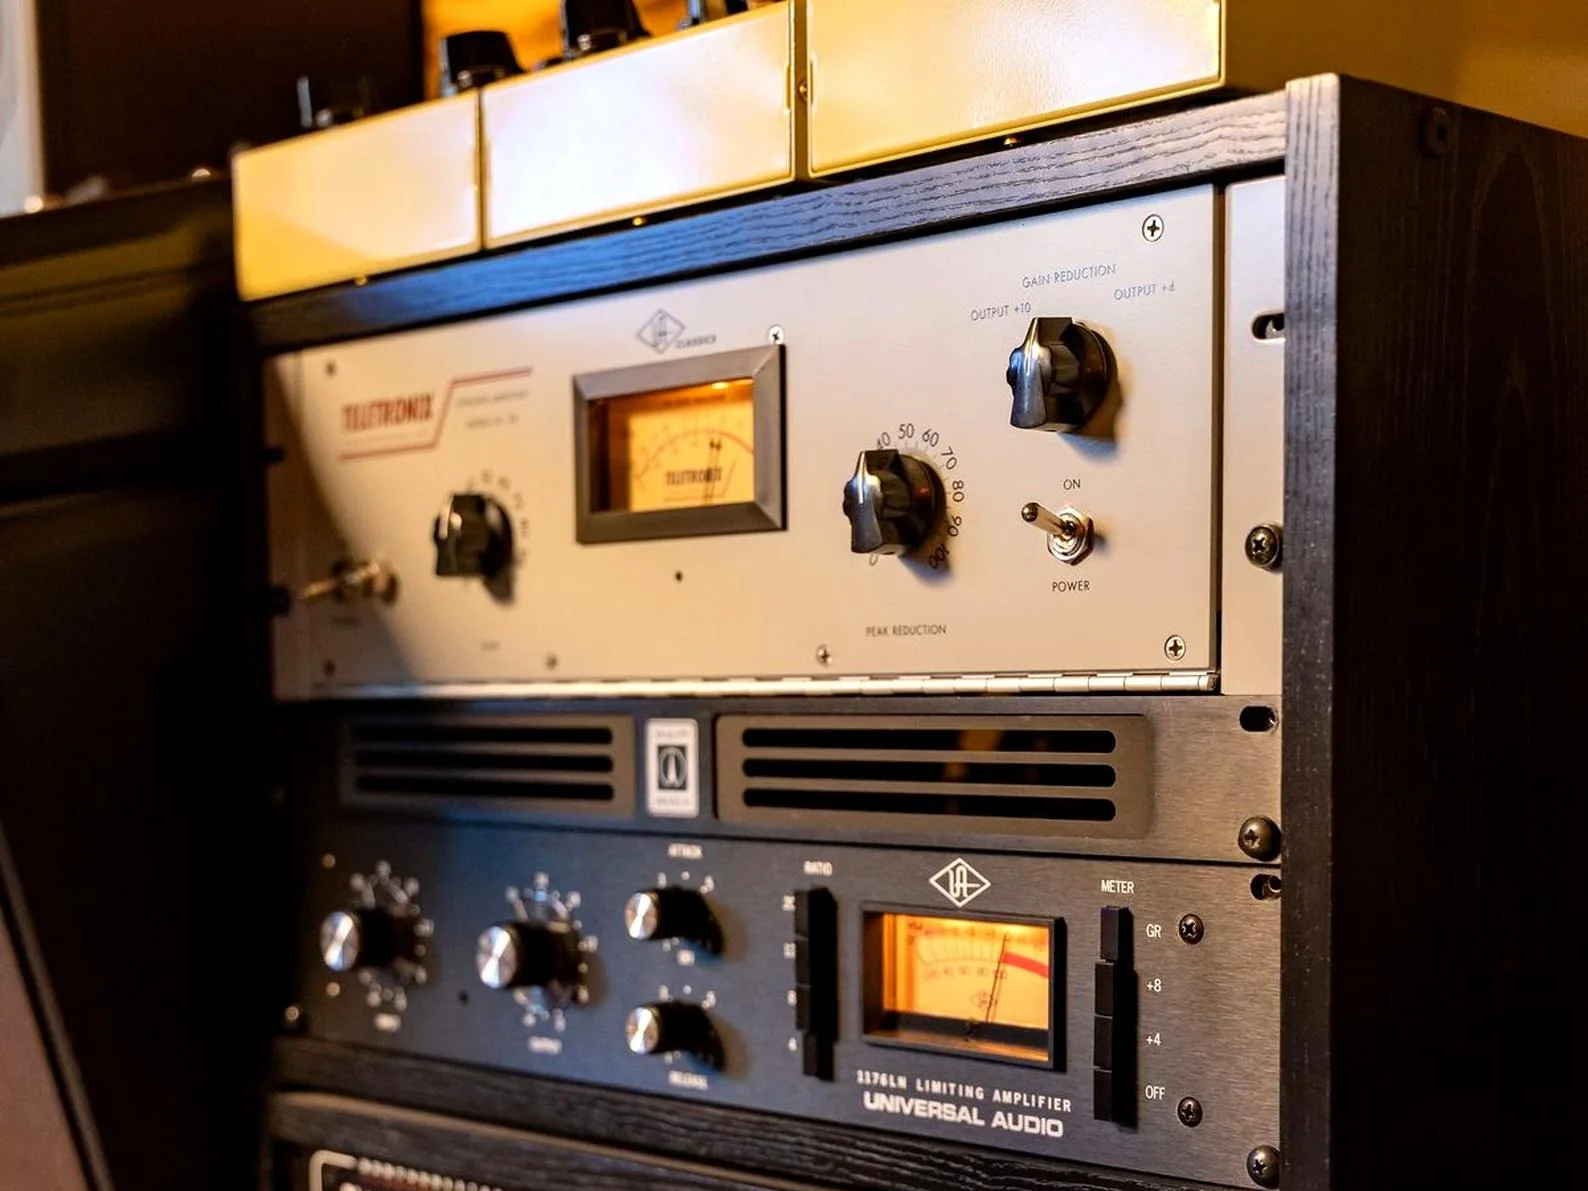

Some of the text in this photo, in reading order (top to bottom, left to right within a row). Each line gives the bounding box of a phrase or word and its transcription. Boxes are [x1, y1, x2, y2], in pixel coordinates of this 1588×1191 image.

[1022, 264, 1117, 288] GAIN REDUCTION
[1113, 284, 1156, 300] OUTPUT
[970, 302, 1032, 321] OUTPUT +10
[898, 423, 915, 440] 50
[922, 428, 940, 447] 60
[941, 447, 958, 470] 70
[952, 480, 965, 503] 80
[1063, 479, 1081, 490] ON
[947, 515, 963, 537] 90
[1052, 580, 1090, 592] POWER
[866, 624, 947, 637] PEAK REDUCTION
[1101, 879, 1134, 894] METER
[1146, 924, 1162, 938] GR
[1146, 979, 1162, 992] +8
[1146, 1033, 1162, 1046] +4
[856, 1070, 1073, 1113] 1176LN LIMITING AMPLIFIER
[1145, 1085, 1165, 1100] OFF
[863, 1091, 1064, 1138] UNIVERSAL AUDIO
